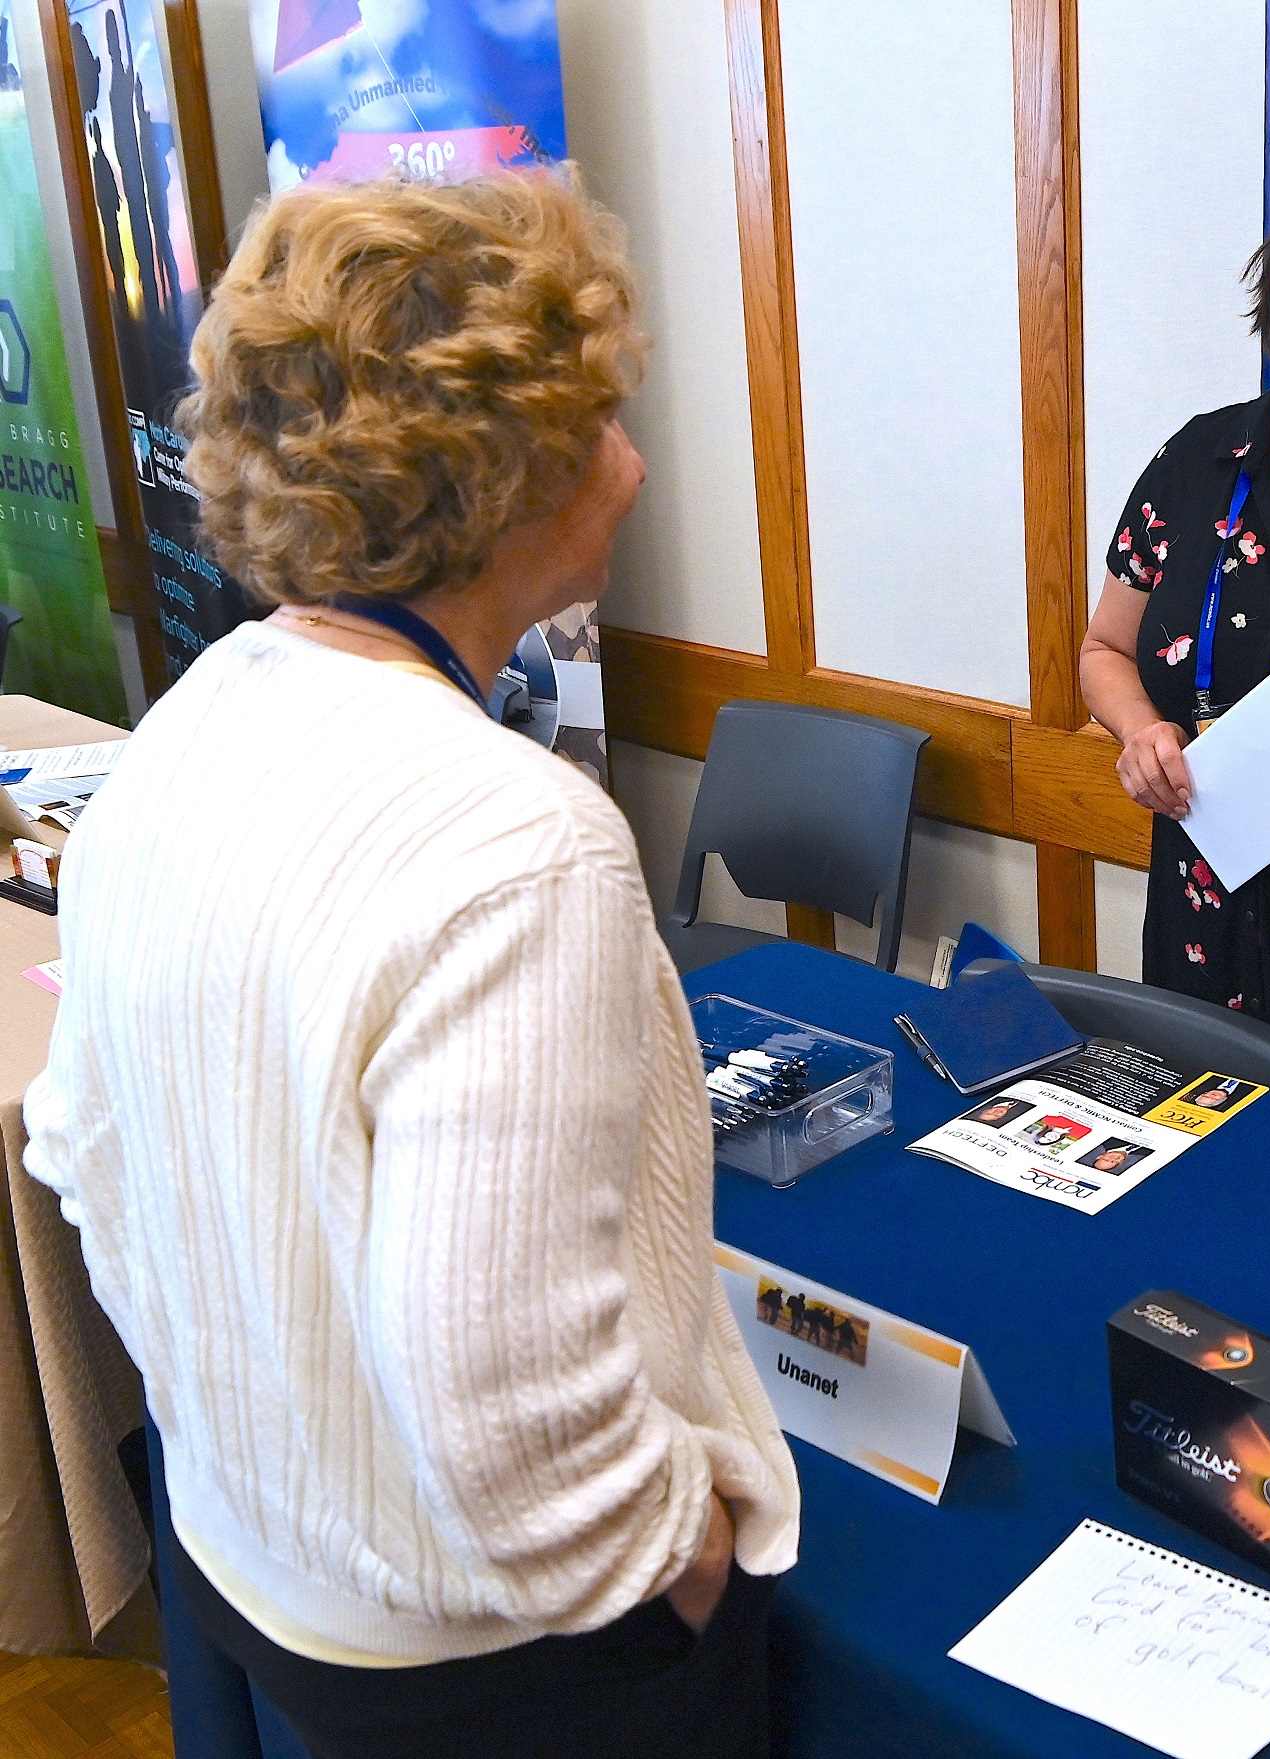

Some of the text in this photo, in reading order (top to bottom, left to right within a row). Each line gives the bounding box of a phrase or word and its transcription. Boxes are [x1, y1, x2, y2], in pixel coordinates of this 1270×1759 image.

[351, 74, 436, 112] Unmanned
[9, 423, 69, 449] BRAGG
[0, 453, 79, 504] EARCH
[0, 503, 85, 538] STITUTE
[1038, 1090, 1075, 1107] DEFTECH
[1080, 1106, 1112, 1122] NCMBC
[1112, 1117, 1143, 1133] Contact
[942, 1129, 1008, 1158] DEFTECH
[998, 1133, 1021, 1147] Team
[1020, 1143, 1064, 1167] Leadership
[1020, 1170, 1094, 1199] ncmbc
[777, 1352, 839, 1400] Unanet
[1124, 1401, 1242, 1483] Titleist
